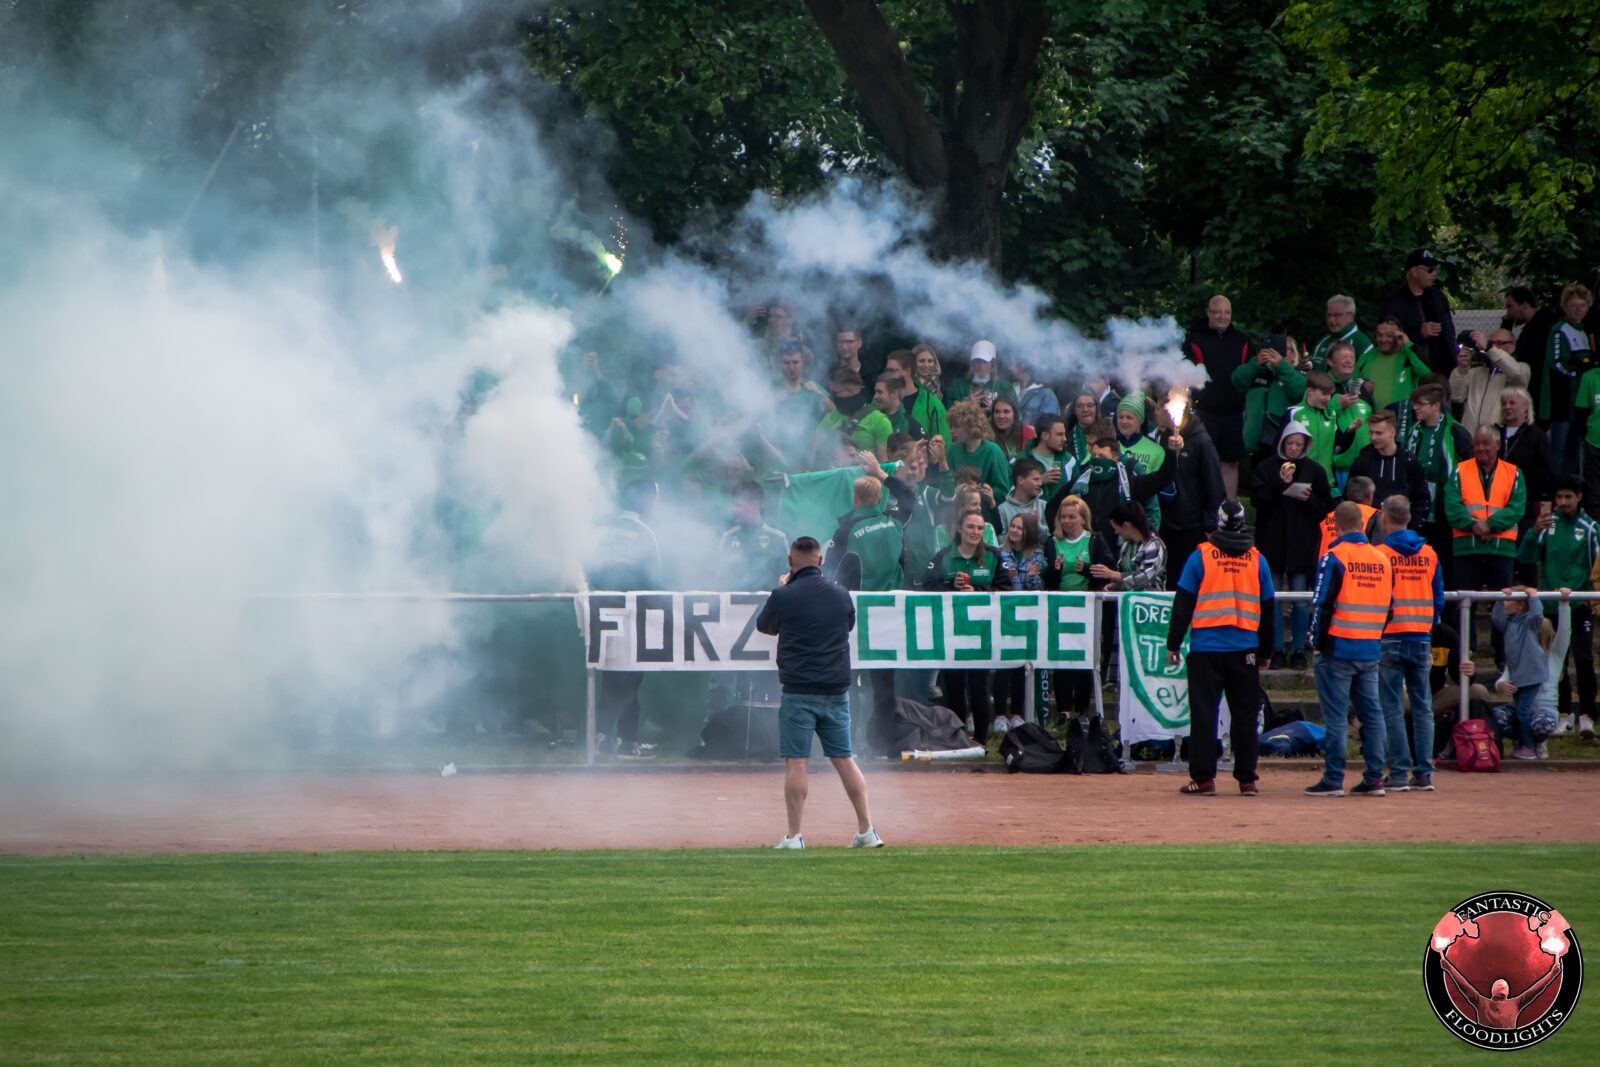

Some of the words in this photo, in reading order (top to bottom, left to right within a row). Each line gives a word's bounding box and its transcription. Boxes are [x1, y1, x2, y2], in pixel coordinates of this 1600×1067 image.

[1347, 562, 1385, 574] ORDNER
[1390, 556, 1430, 567] ORDNER
[1134, 604, 1171, 624] DRE
[588, 594, 770, 663] FORZ
[856, 595, 1086, 661] COSSE
[1041, 669, 1050, 701] COS
